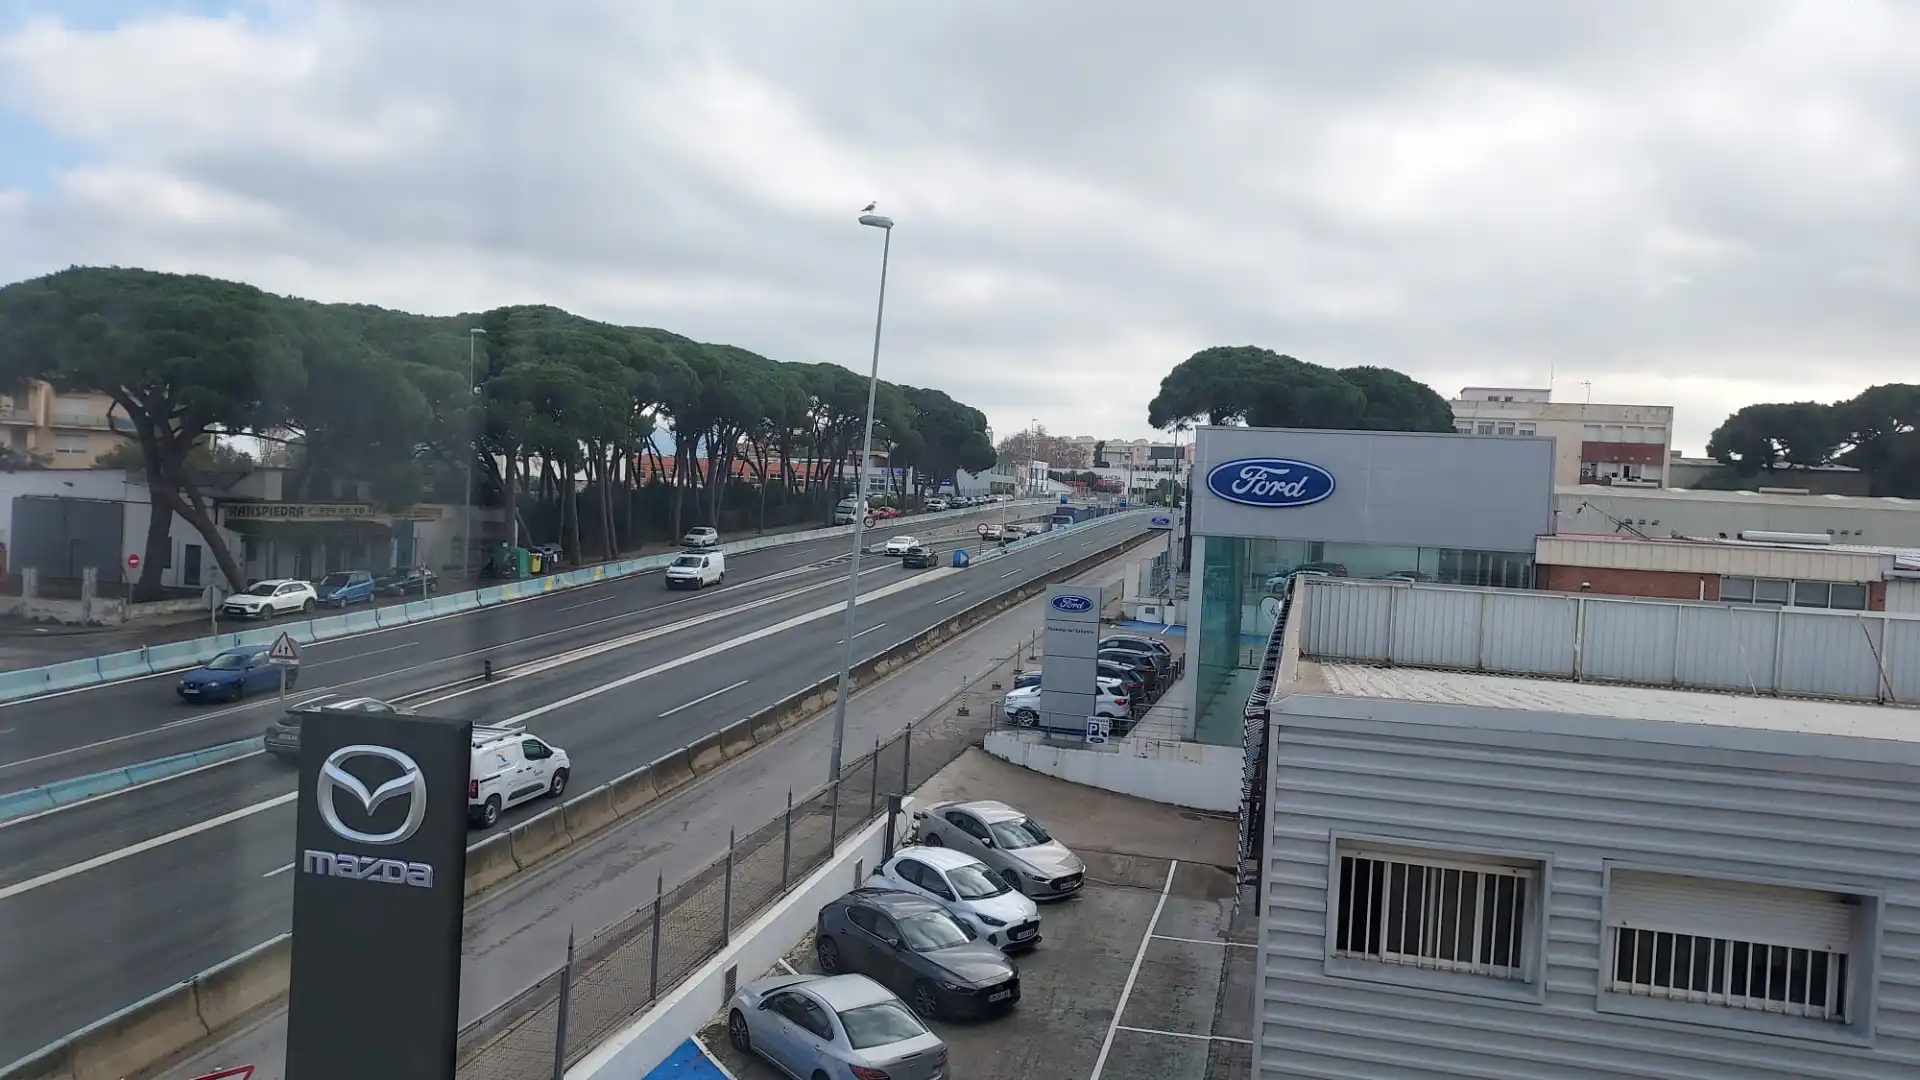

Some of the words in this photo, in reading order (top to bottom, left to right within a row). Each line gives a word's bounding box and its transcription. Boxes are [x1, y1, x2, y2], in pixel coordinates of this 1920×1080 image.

[1231, 466, 1309, 497] Ford
[1059, 597, 1085, 609] Ford
[1089, 723, 1098, 735] P
